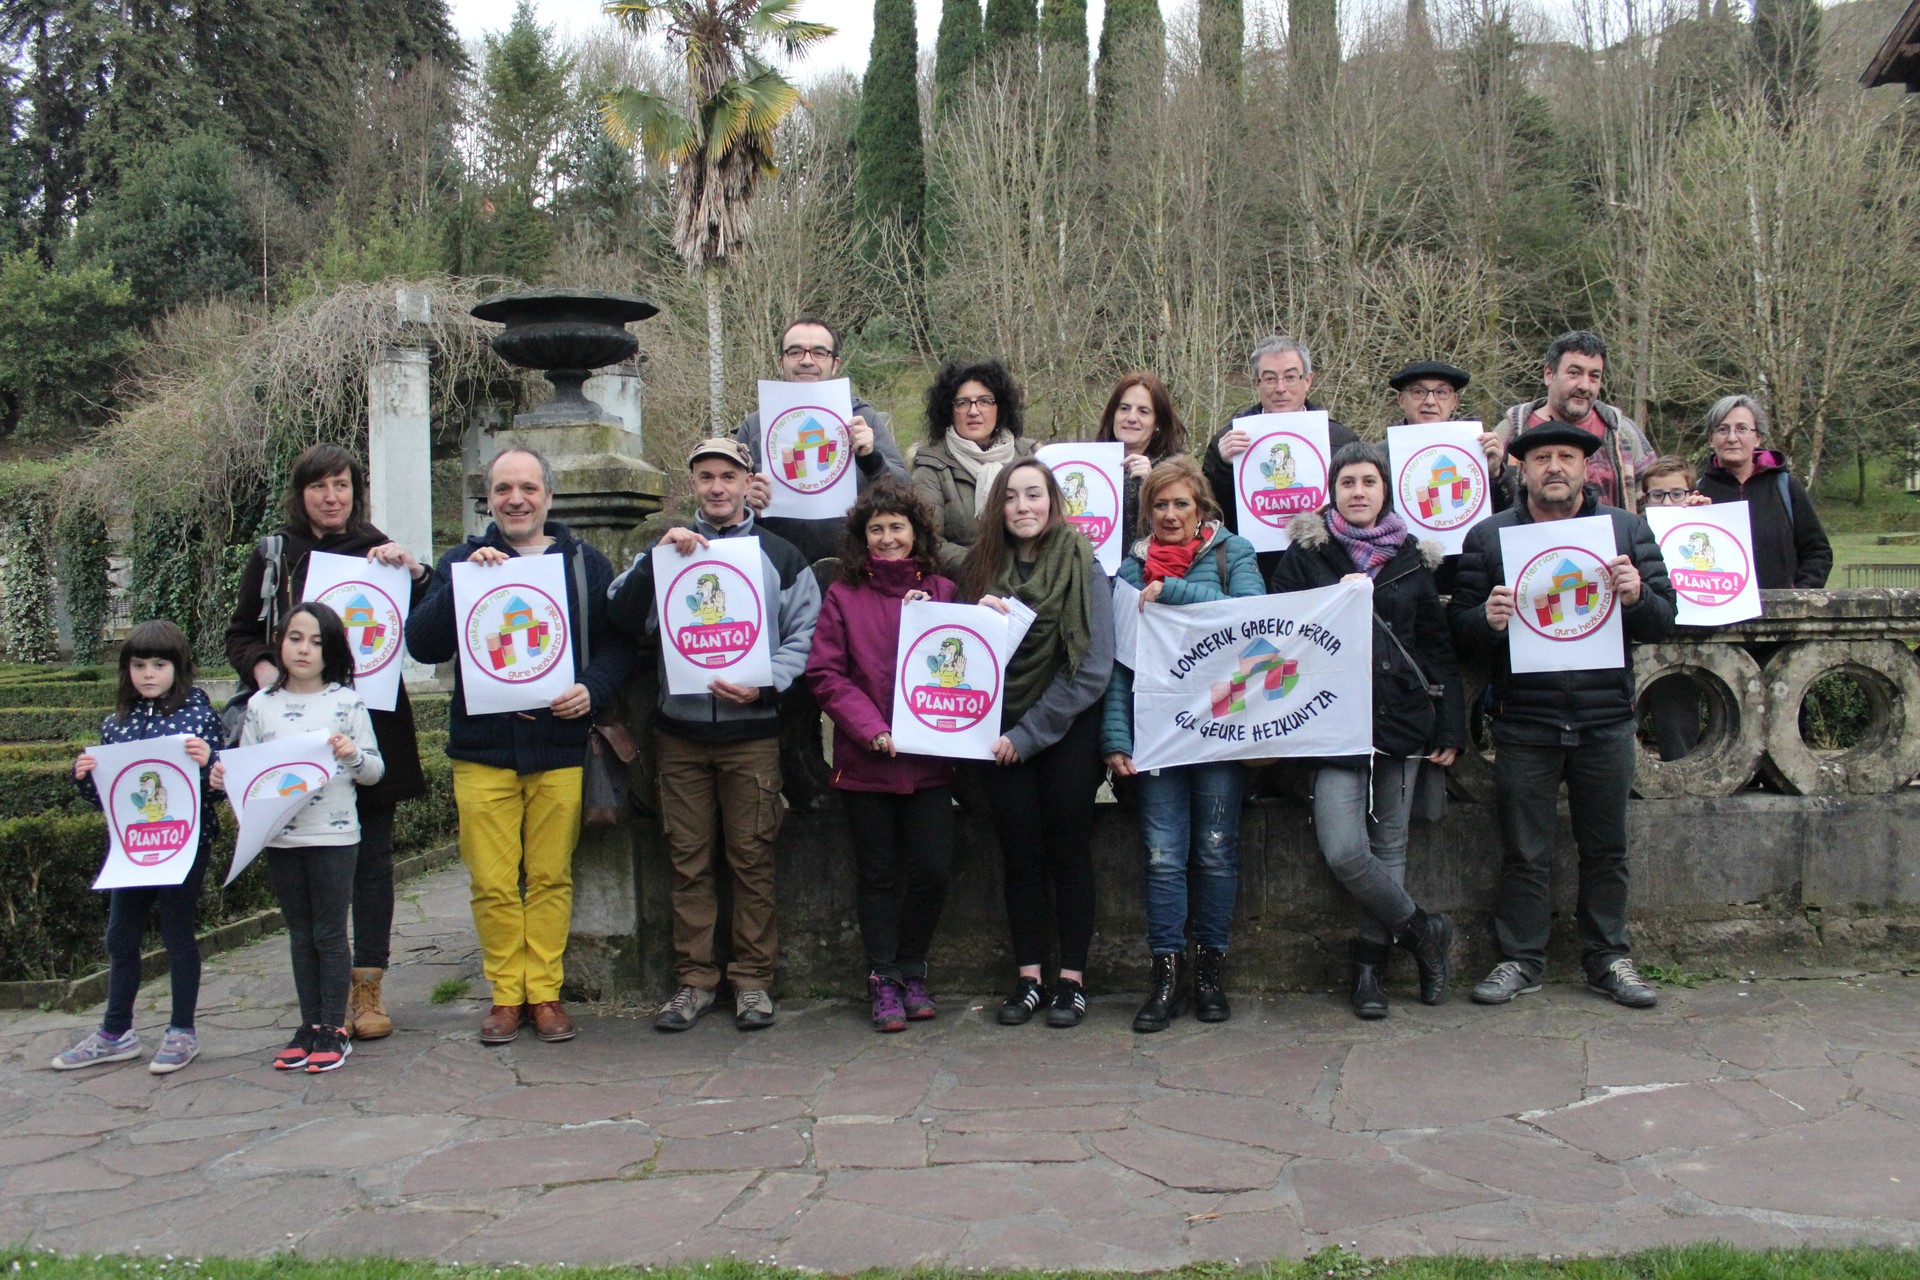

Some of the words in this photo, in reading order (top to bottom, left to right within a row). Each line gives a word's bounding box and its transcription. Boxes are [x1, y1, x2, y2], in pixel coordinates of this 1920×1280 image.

[775, 410, 805, 430] Herrian
[798, 482, 819, 490] gure
[819, 450, 847, 486] hezkuntza
[1402, 473, 1412, 502] Euskal
[1407, 448, 1438, 472] Herrian
[1255, 490, 1317, 511] PLANTO!
[1434, 518, 1454, 528] gure
[1454, 487, 1482, 523] hezkuntza
[1523, 551, 1559, 581] Herrian
[1518, 581, 1529, 610] Euskal
[1673, 572, 1738, 591] PLANTO!
[474, 588, 510, 617] Herrian
[1554, 627, 1578, 638] gure
[1578, 592, 1611, 633] hezkuntza
[469, 617, 481, 651] Euskal
[681, 626, 750, 649] PLANTO!
[1170, 626, 1237, 680] LOMCERIK
[1241, 618, 1294, 640] GABEKO
[1297, 623, 1341, 656] HERRIA
[360, 638, 397, 671] hezkuntza
[507, 668, 531, 680] gure
[531, 633, 562, 675] hezkuntza
[915, 690, 984, 715] PLANTO!
[1200, 720, 1246, 742] GEURE
[1252, 689, 1339, 742] HEZKUNTZA
[248, 770, 281, 798] Herrian
[128, 824, 185, 848] PLANTO!
